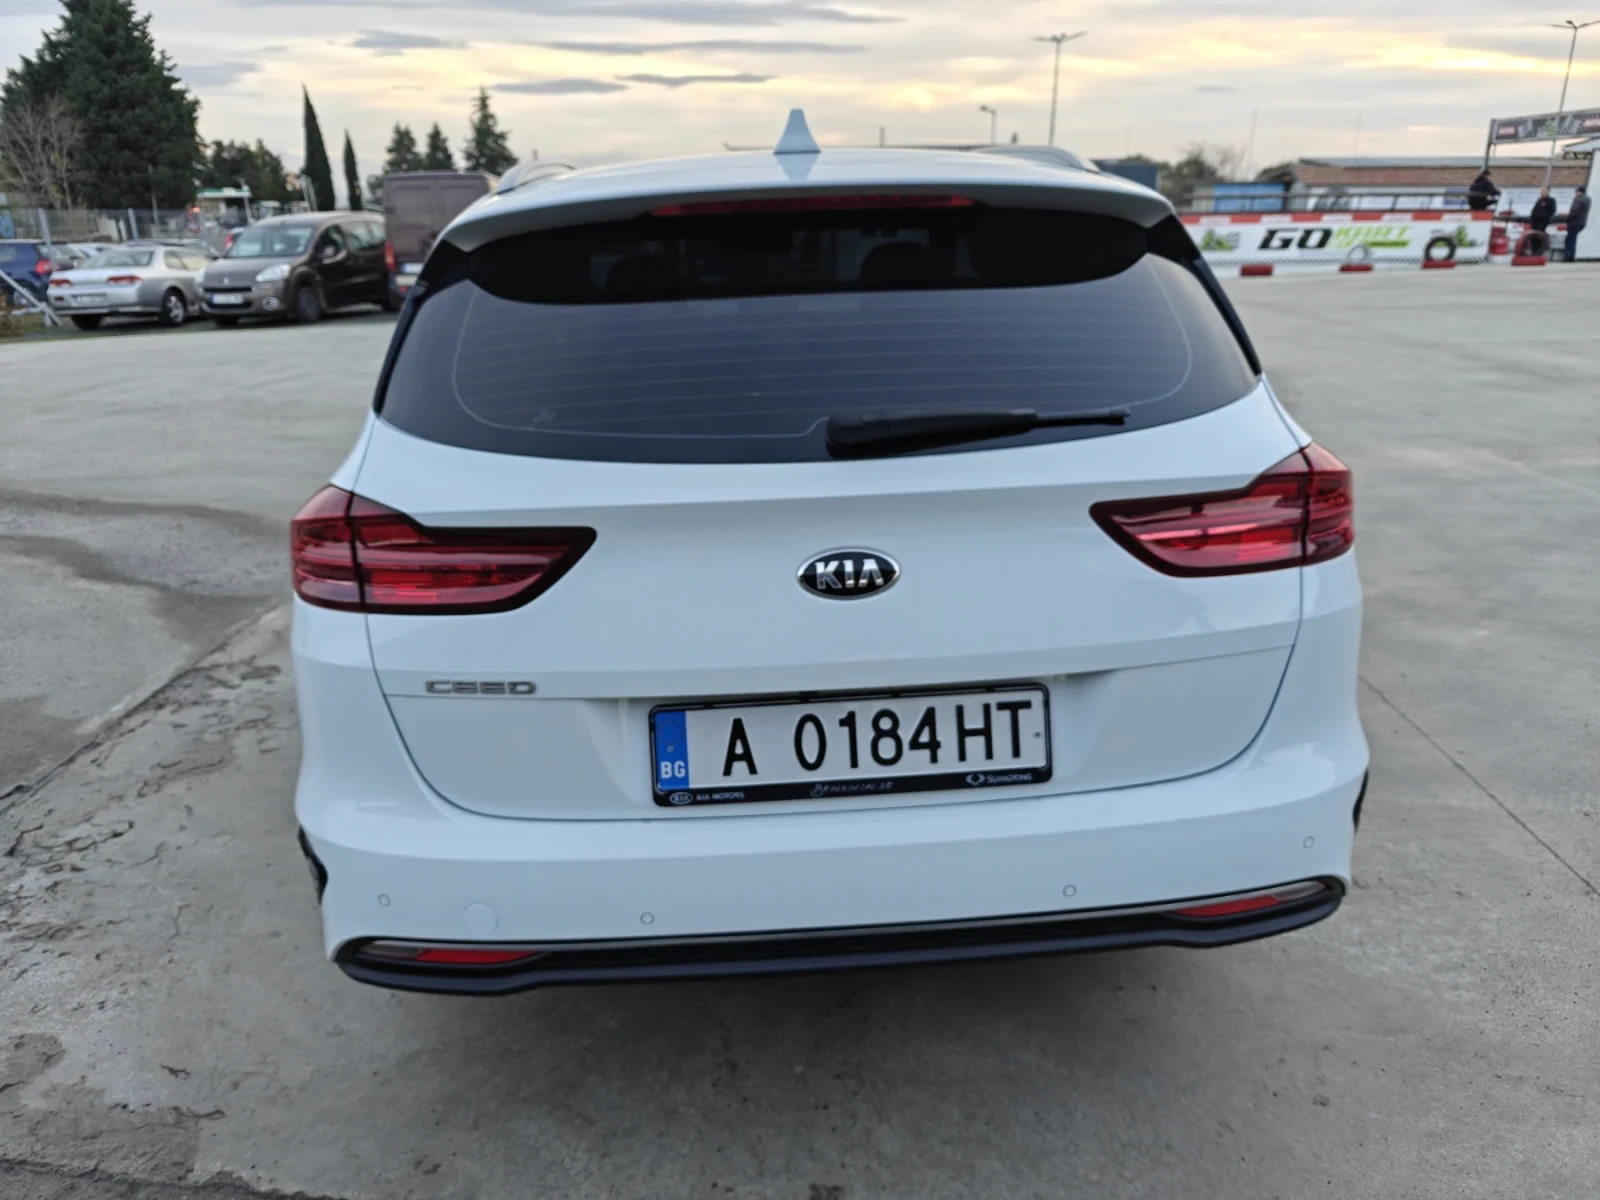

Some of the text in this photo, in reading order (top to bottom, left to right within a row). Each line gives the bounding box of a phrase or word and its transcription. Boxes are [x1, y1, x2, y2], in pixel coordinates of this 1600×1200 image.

[1258, 228, 1333, 250] GO
[815, 558, 884, 589] KIA
[722, 717, 758, 777] A
[661, 760, 686, 779] BG
